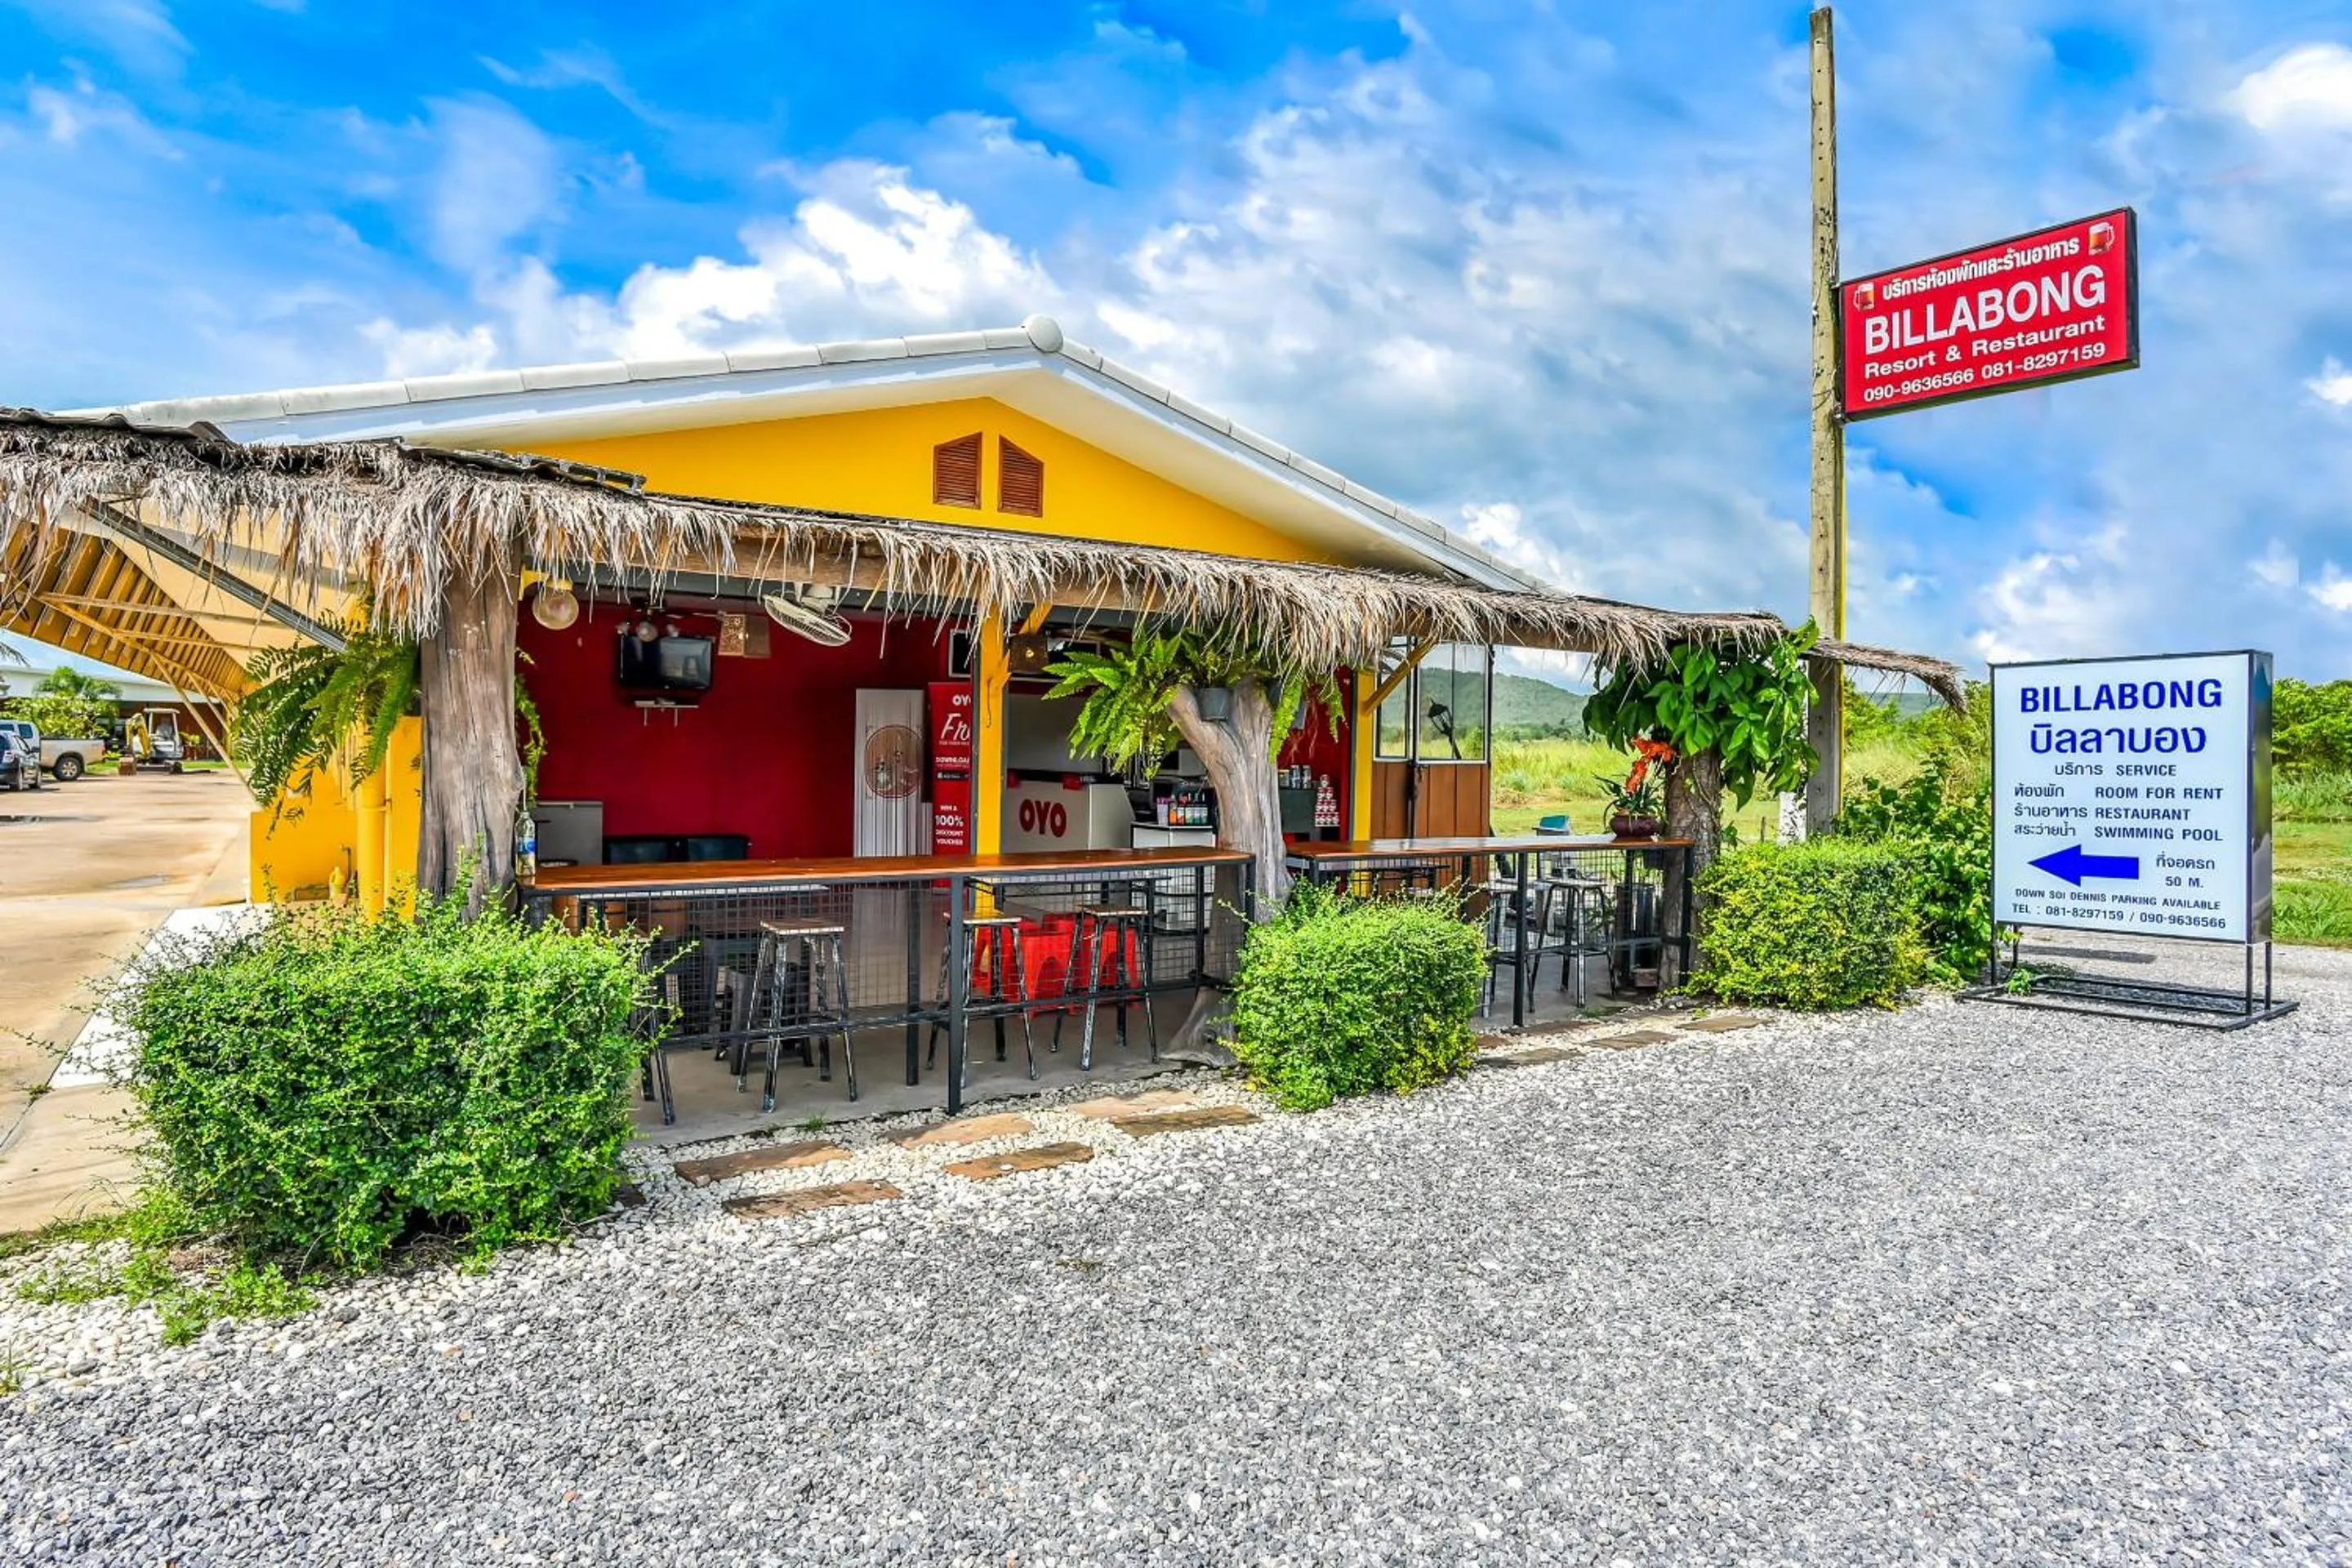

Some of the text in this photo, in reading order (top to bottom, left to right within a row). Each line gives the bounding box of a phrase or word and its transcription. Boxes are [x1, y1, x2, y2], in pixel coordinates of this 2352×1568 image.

[1883, 238, 2079, 300] บริการห้องพักและร้านอาหาร
[1865, 265, 2105, 354] BILLABONG
[1865, 315, 2105, 379] Resort & Restaurant
[1864, 343, 2105, 402] 090-9636566 081-8297159
[2020, 679, 2222, 712] BILLABONG
[2030, 724, 2207, 754] บิลลาบอง
[2056, 762, 2103, 776] บริการ
[2116, 764, 2177, 777] SERVICE
[2014, 782, 2065, 798] ห้องพัก
[2096, 786, 2224, 800] ROOM FOR RENT
[1019, 799, 1067, 838] OYO
[2014, 803, 2087, 817] ร้านอาหาร
[2096, 807, 2190, 821] RESTAURANT
[935, 815, 964, 826] 100%
[2014, 821, 2076, 836] สระว่ายน้ำ
[2095, 826, 2223, 841] SWIMMING POOL
[2156, 851, 2215, 870] ที่จอดรถ
[2165, 876, 2203, 888] 50 M.
[2016, 888, 2221, 910] DOWN SOI DENNIS PARKING AVAILABLE
[2012, 903, 2030, 914] TEL
[2046, 905, 2124, 921] 081-8297159
[2140, 911, 2226, 929] 090-9636566
